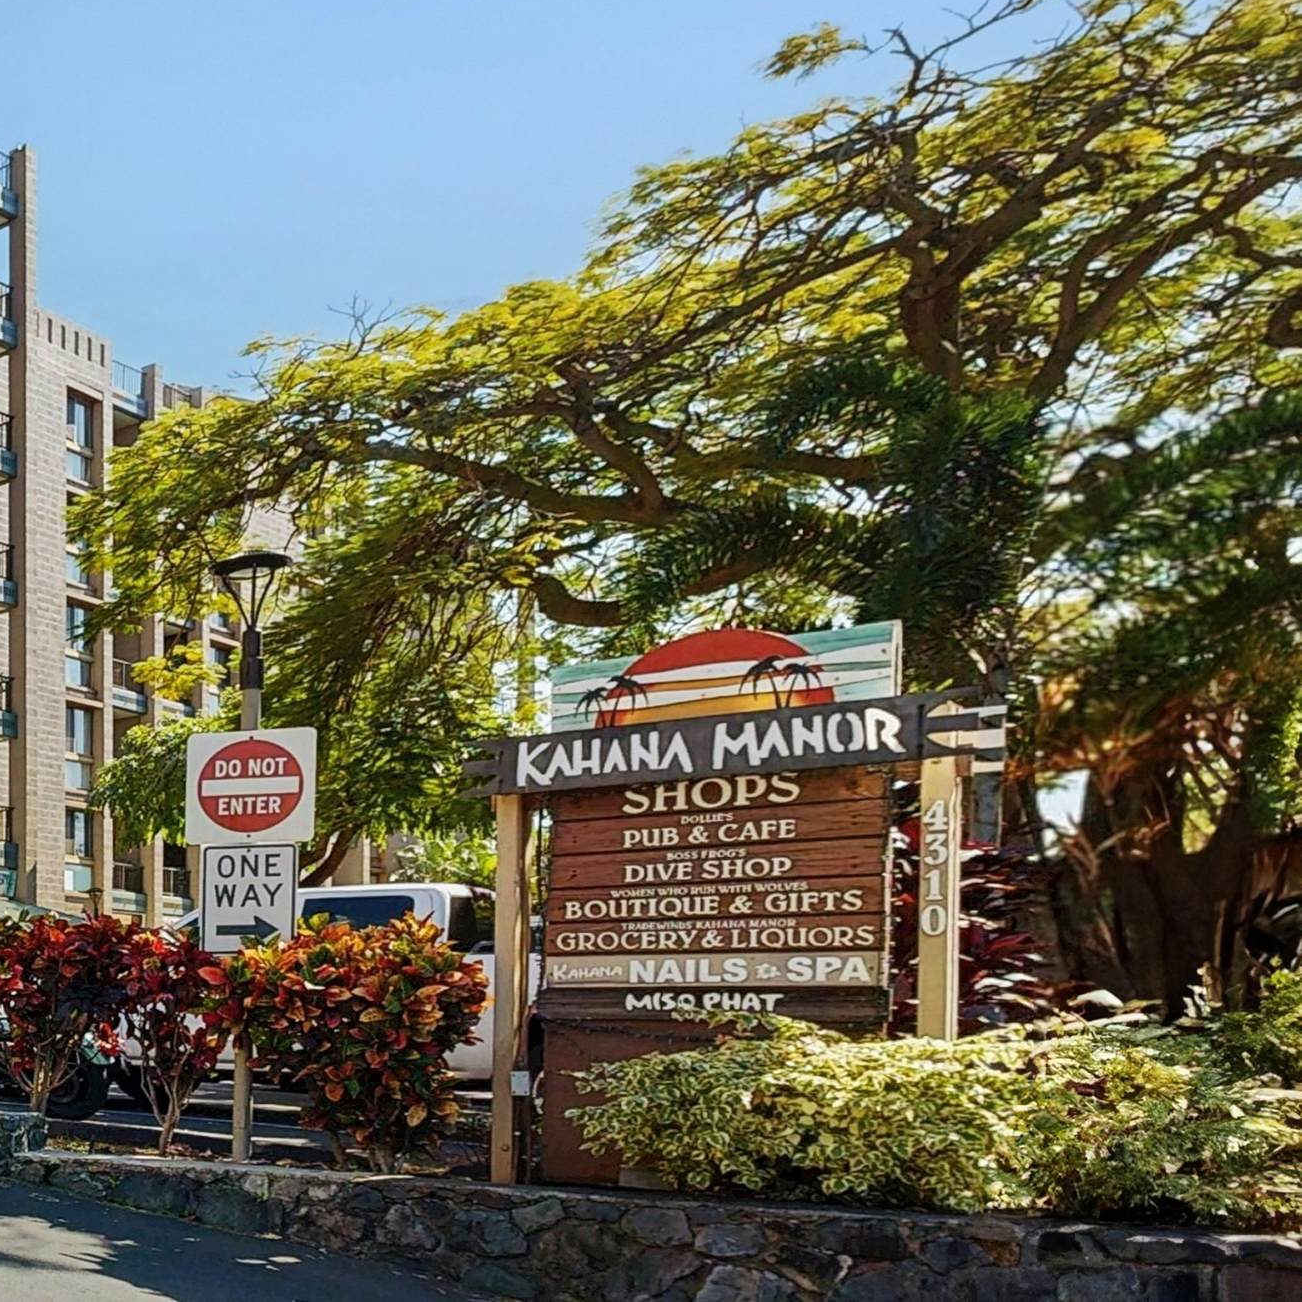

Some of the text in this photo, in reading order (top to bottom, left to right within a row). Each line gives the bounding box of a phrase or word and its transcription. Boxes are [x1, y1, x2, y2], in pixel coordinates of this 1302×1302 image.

[516, 708, 907, 788] KAHANA MANOR
[215, 757, 288, 778] DO NOT
[621, 772, 801, 815] SHOPS
[218, 796, 281, 816] ENTER
[681, 813, 734, 825] DOLLIE'S
[623, 819, 797, 848] PUB & CAFE
[217, 854, 281, 878] ONE
[667, 849, 746, 861] BOSS FROG'S
[624, 857, 792, 883] DIVE SHOP
[921, 800, 948, 936] 4310
[214, 883, 283, 907] WAY
[610, 881, 809, 898] WOMEN WHO RUN WITH WOLVES
[565, 889, 863, 920] BOUTIQUE & GIFTS
[622, 918, 796, 931] TRADEWINDS KAHANA MANOR
[556, 925, 875, 952] GROCERY & LIQUORS
[552, 956, 871, 984] KAHANA NAILS SPA
[702, 992, 785, 1012] PHAT
